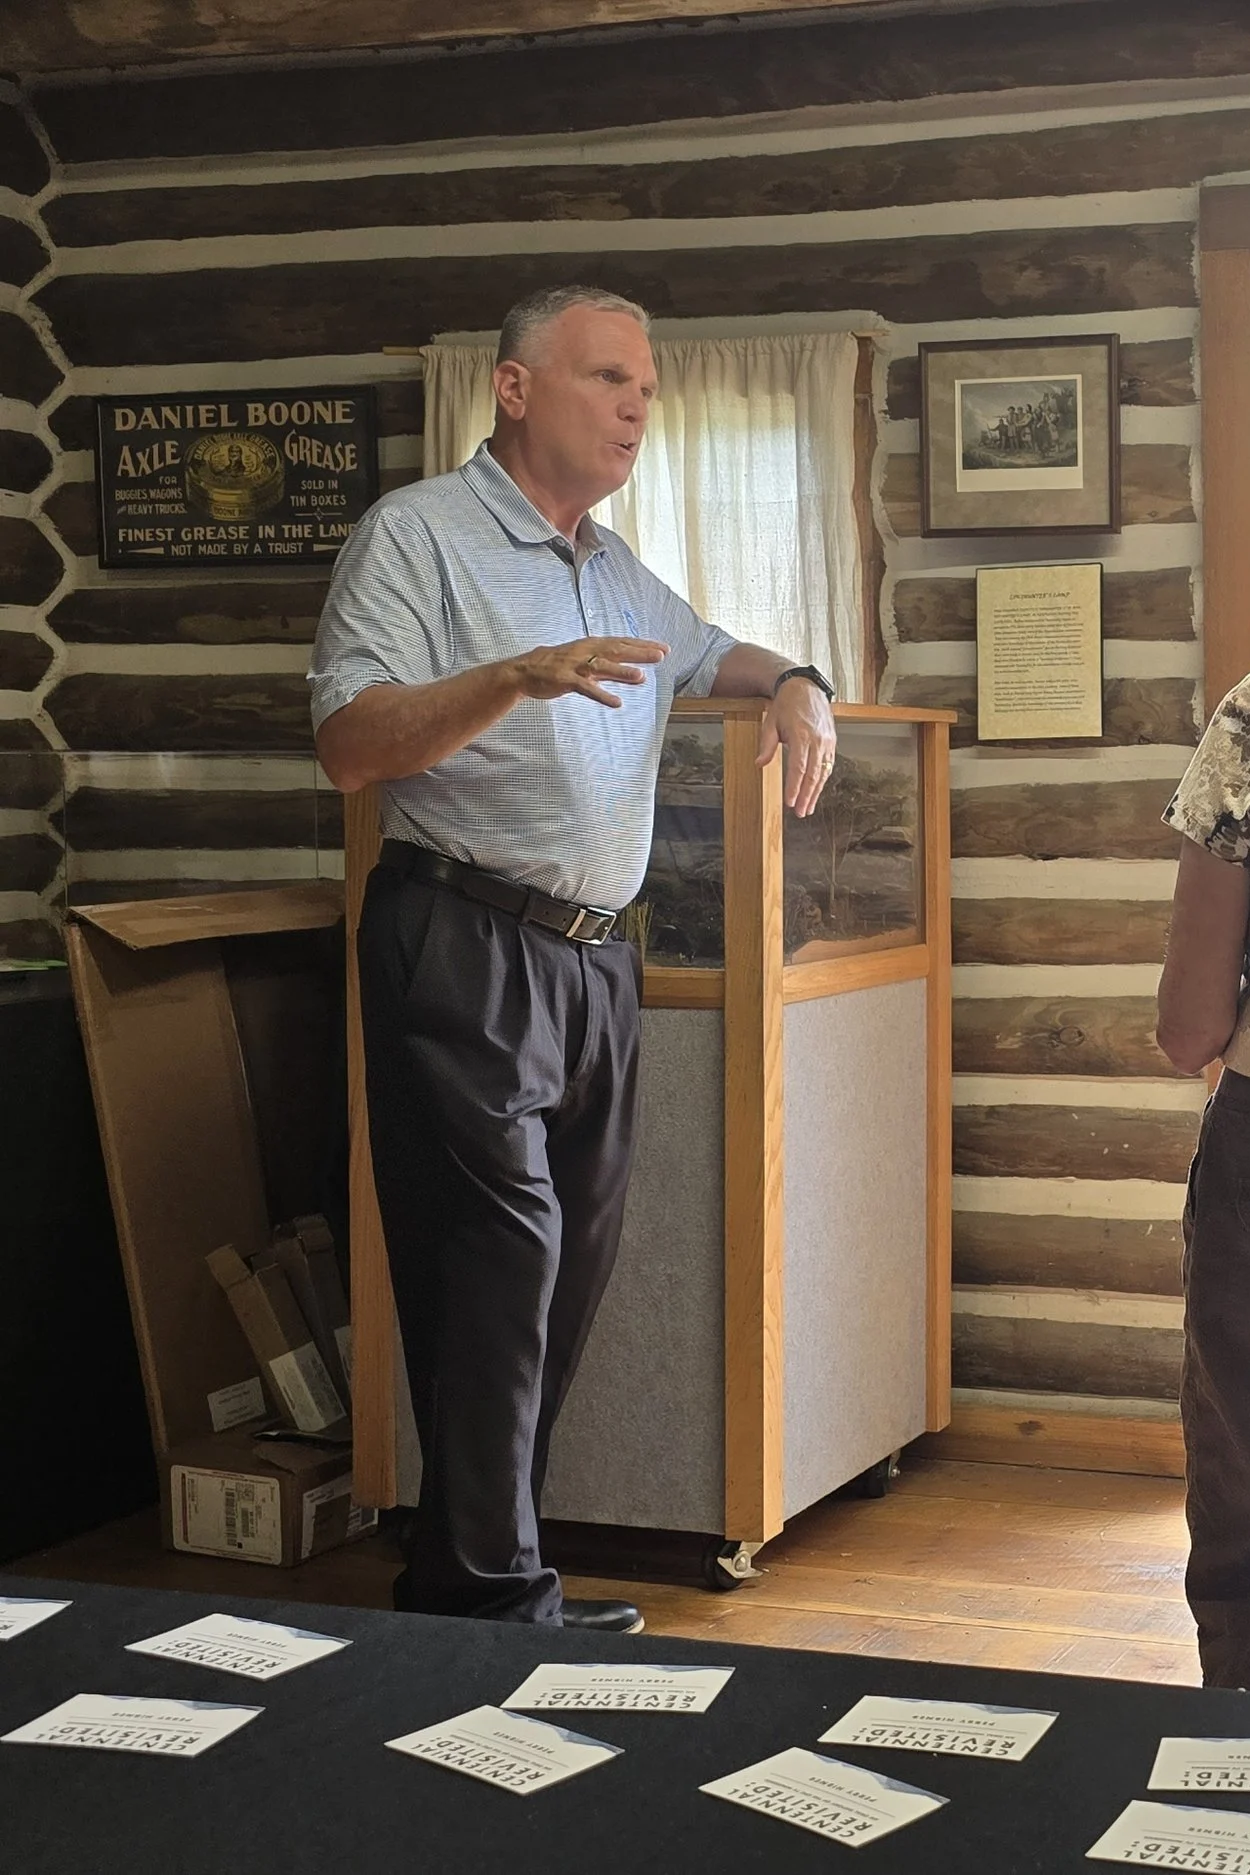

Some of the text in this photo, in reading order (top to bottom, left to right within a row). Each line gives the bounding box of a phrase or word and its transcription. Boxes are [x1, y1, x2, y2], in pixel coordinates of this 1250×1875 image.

[113, 400, 356, 431] DANIEL BOONE
[116, 440, 181, 478] AXLE
[284, 429, 358, 474] GREASE
[159, 476, 178, 485] FOR
[300, 479, 339, 490] SOLD IN
[149, 487, 183, 500] WAGONS
[290, 494, 348, 507] TIN BOXES
[127, 504, 153, 515] HEAVY
[118, 528, 176, 542] FINEST
[181, 526, 250, 540] GREASE
[258, 524, 276, 538] IN
[282, 523, 313, 538] THE
[171, 542, 304, 556] NOT MADE BY A TRUST
[152, 1645, 266, 1675] CENTENNIAL
[168, 1640, 281, 1668] REVISITED:
[533, 1699, 692, 1709] CENTENNIAL
[540, 1692, 697, 1702] REVISITED:
[36, 1734, 188, 1752] CENTENNIAL
[49, 1726, 200, 1744] REVISITED:
[858, 1727, 1016, 1749] REVISITED:
[850, 1735, 1009, 1756] CENTENNIAL
[410, 1742, 528, 1787] CENTENNIAL
[430, 1737, 545, 1779] REVISITED:
[727, 1788, 856, 1839] CENTENNIAL
[743, 1781, 873, 1831] REVISITED:
